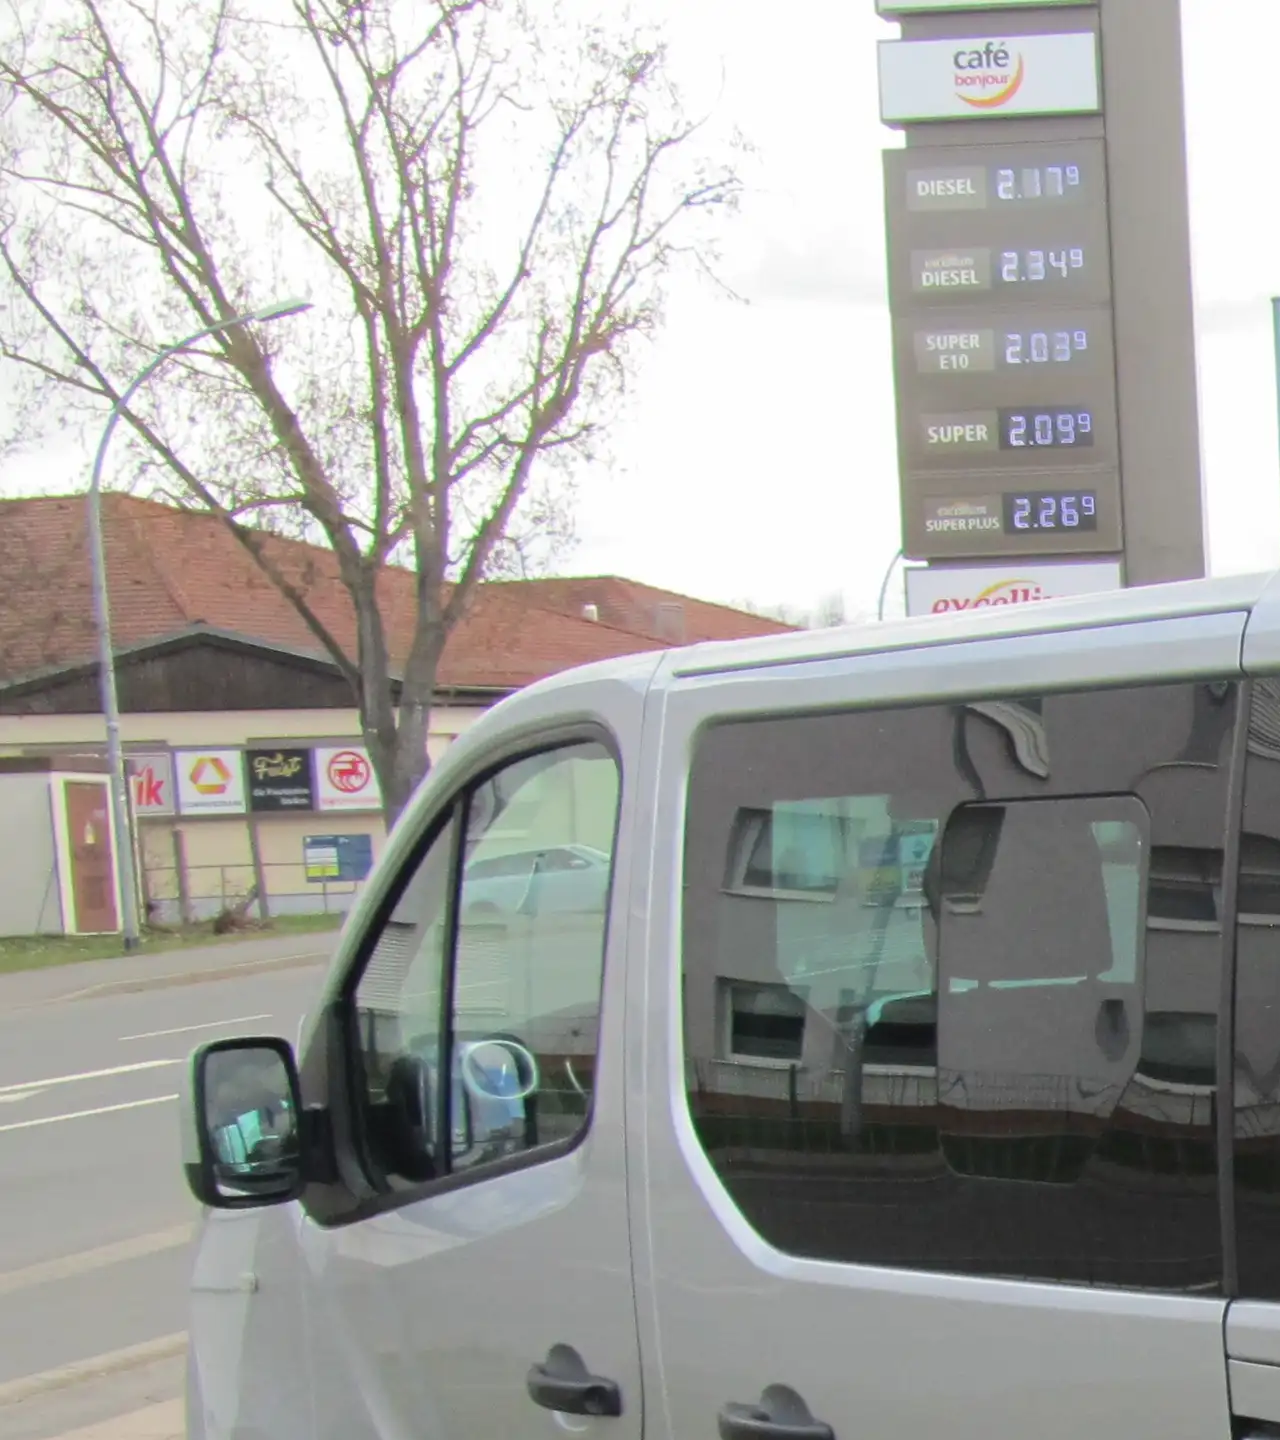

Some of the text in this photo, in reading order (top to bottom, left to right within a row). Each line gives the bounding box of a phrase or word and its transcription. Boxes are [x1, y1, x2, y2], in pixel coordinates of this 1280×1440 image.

[953, 42, 1009, 69] café
[954, 73, 1010, 89] bonjour
[917, 178, 976, 196] DIESEL
[921, 270, 980, 287] DIESEL
[926, 333, 980, 351] SUPER
[939, 354, 969, 370] E10
[927, 424, 988, 444] SUPER
